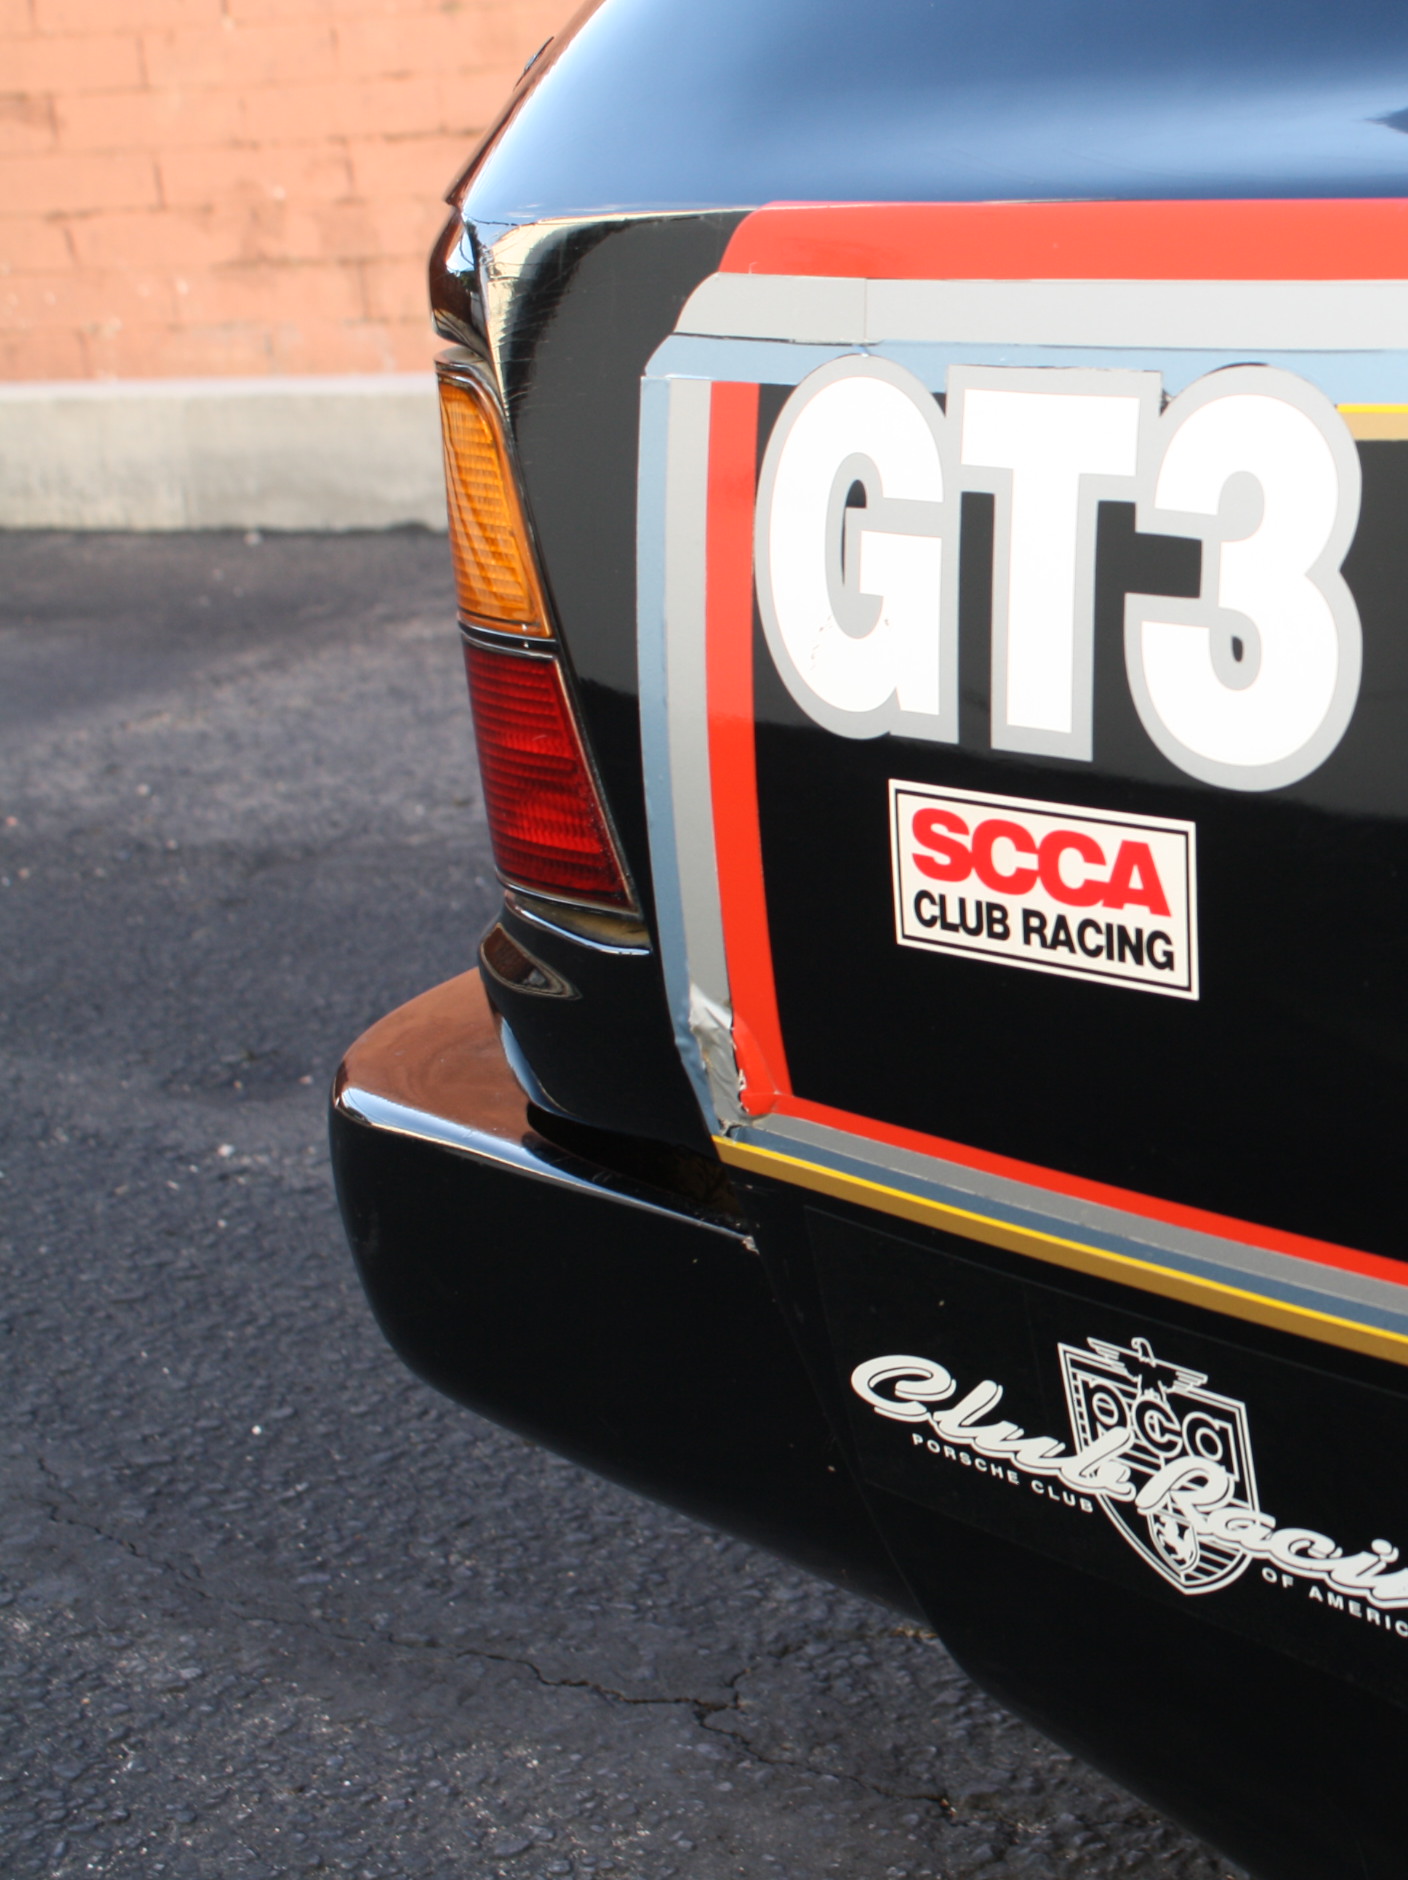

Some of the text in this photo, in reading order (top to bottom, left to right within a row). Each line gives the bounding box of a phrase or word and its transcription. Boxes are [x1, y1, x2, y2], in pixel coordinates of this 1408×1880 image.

[754, 354, 1363, 791] GT3
[912, 807, 1171, 917] SCCA
[914, 889, 1174, 971] CLUB RACING
[851, 1354, 1137, 1502] Club
[911, 1433, 1020, 1486] PORSCHE
[1031, 1479, 1094, 1513] CLUB
[1261, 1566, 1294, 1588] OF
